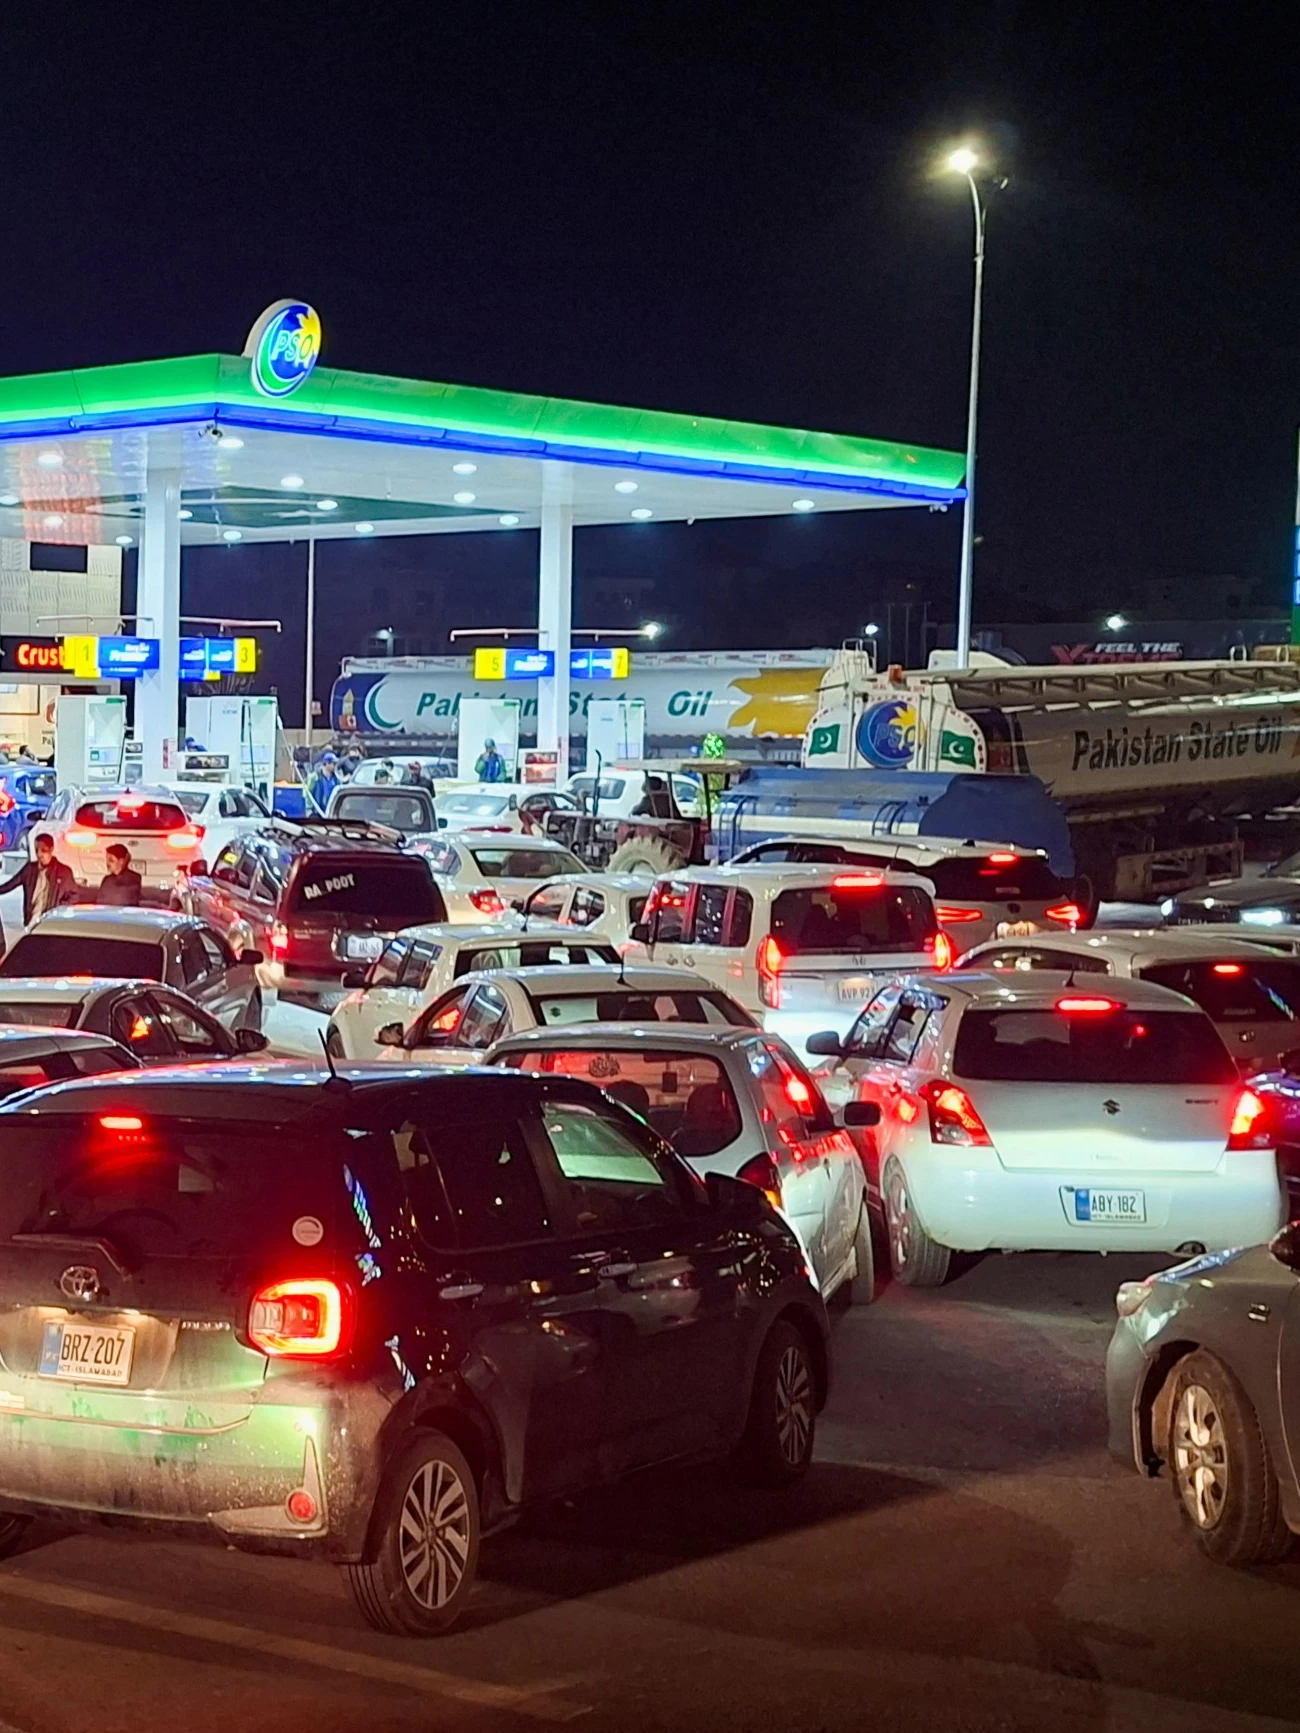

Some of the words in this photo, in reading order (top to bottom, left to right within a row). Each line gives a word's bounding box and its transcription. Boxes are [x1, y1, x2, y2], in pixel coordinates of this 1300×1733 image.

[271, 329, 313, 361] PSO
[240, 647, 248, 663] 3
[1095, 643, 1137, 653] FEEL
[1141, 642, 1180, 652] THE
[492, 658, 499, 672] 5
[617, 656, 623, 670] 7
[667, 690, 711, 716] Oil
[874, 723, 917, 751] PSO
[1072, 727, 1182, 771] Pakistan
[1187, 721, 1250, 761] State
[1255, 716, 1283, 754] Oil
[1091, 1195, 1113, 1212] ABY
[1117, 1195, 1137, 1213] 182
[61, 1333, 92, 1362] BRZ
[94, 1333, 126, 1365] 207
